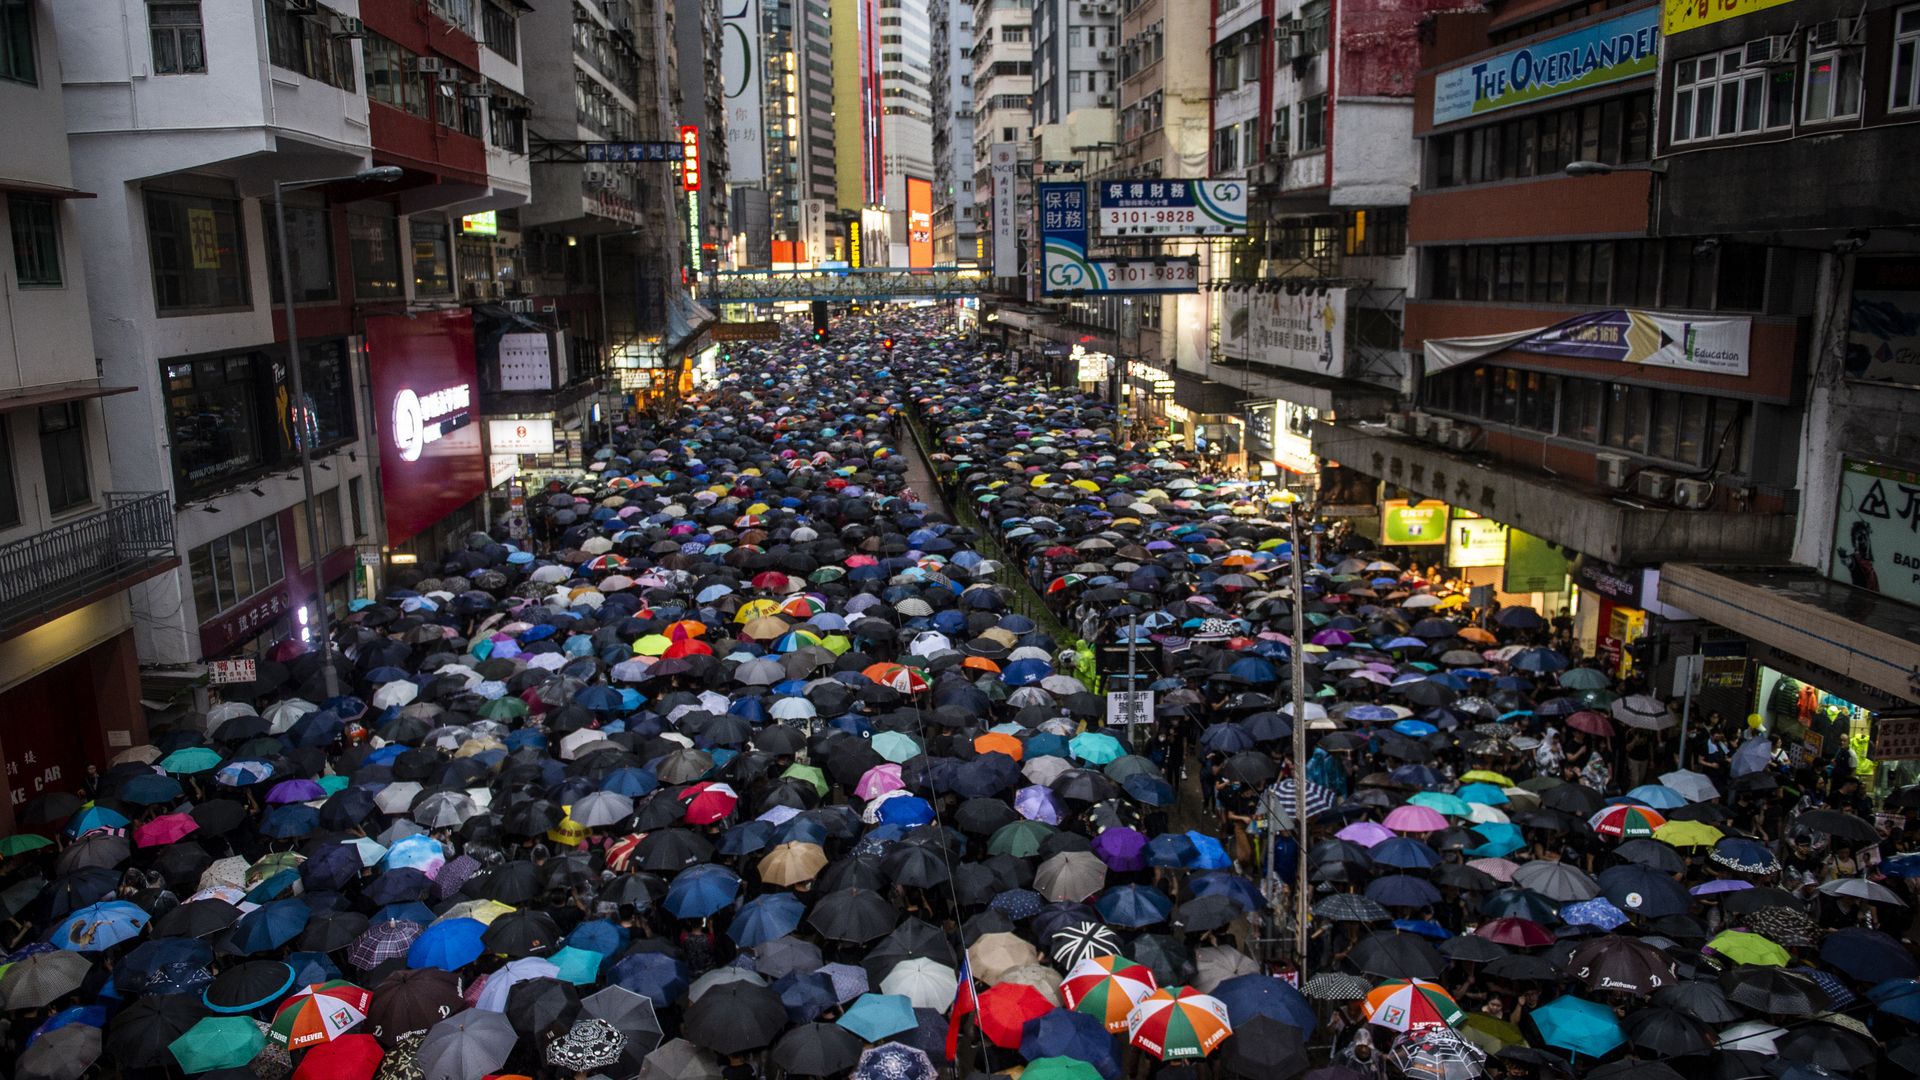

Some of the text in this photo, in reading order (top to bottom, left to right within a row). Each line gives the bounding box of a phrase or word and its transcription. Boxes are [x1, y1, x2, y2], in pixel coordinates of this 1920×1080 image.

[1472, 63, 1505, 101] THE
[1109, 183, 1185, 199] 保得財務
[1045, 191, 1081, 209] 保得
[1046, 212, 1082, 229] 財務
[1111, 210, 1195, 224] 3101-9828
[1108, 267, 1195, 281] 3101-9828
[1694, 347, 1740, 361] Education
[293, 1031, 324, 1045] 7-ELEVEN
[1138, 1035, 1162, 1055] 7-ELEVEN
[1167, 1046, 1199, 1056] 7-ELEVEN
